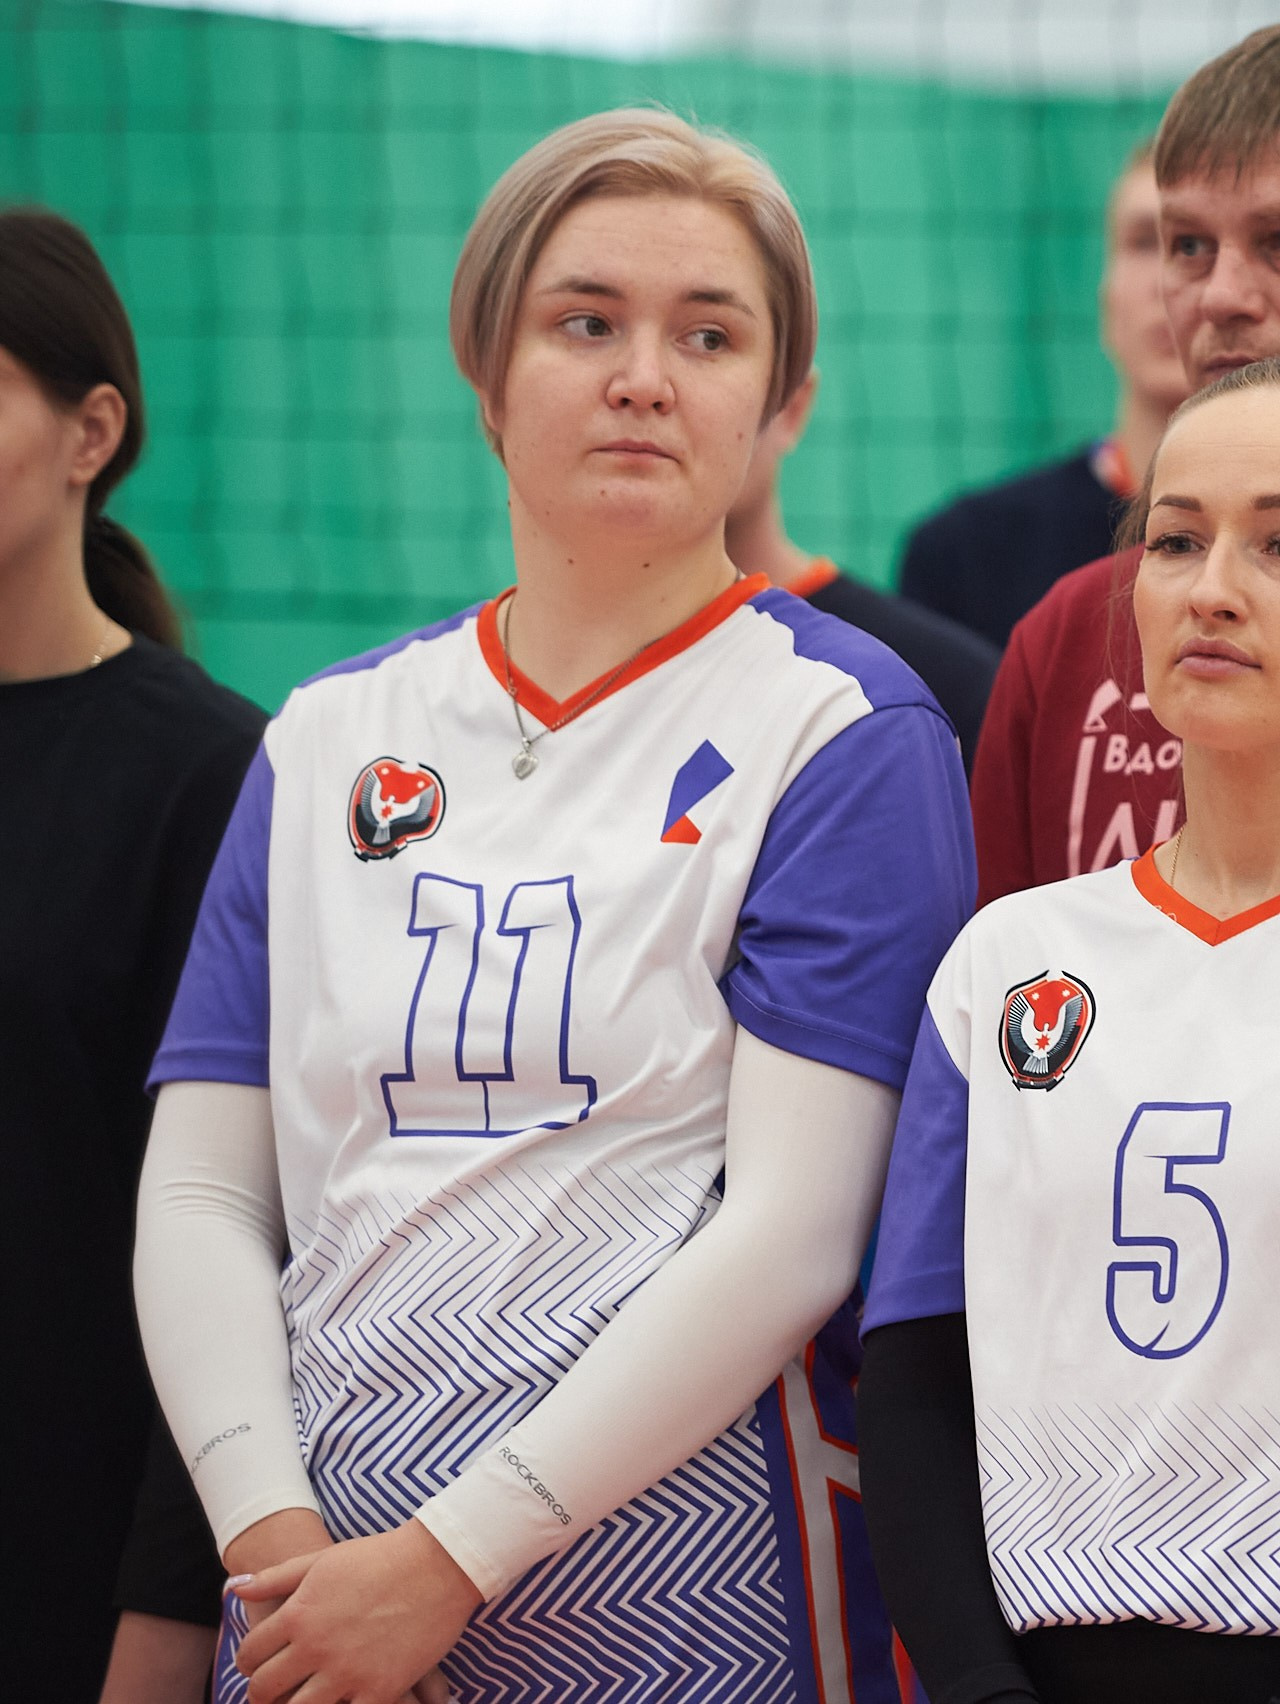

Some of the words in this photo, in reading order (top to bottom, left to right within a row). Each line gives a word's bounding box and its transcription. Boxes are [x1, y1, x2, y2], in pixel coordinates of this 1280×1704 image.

[380, 872, 598, 1138] 11
[1106, 1101, 1232, 1360] 5
[499, 1446, 572, 1526] ROCKBROS
